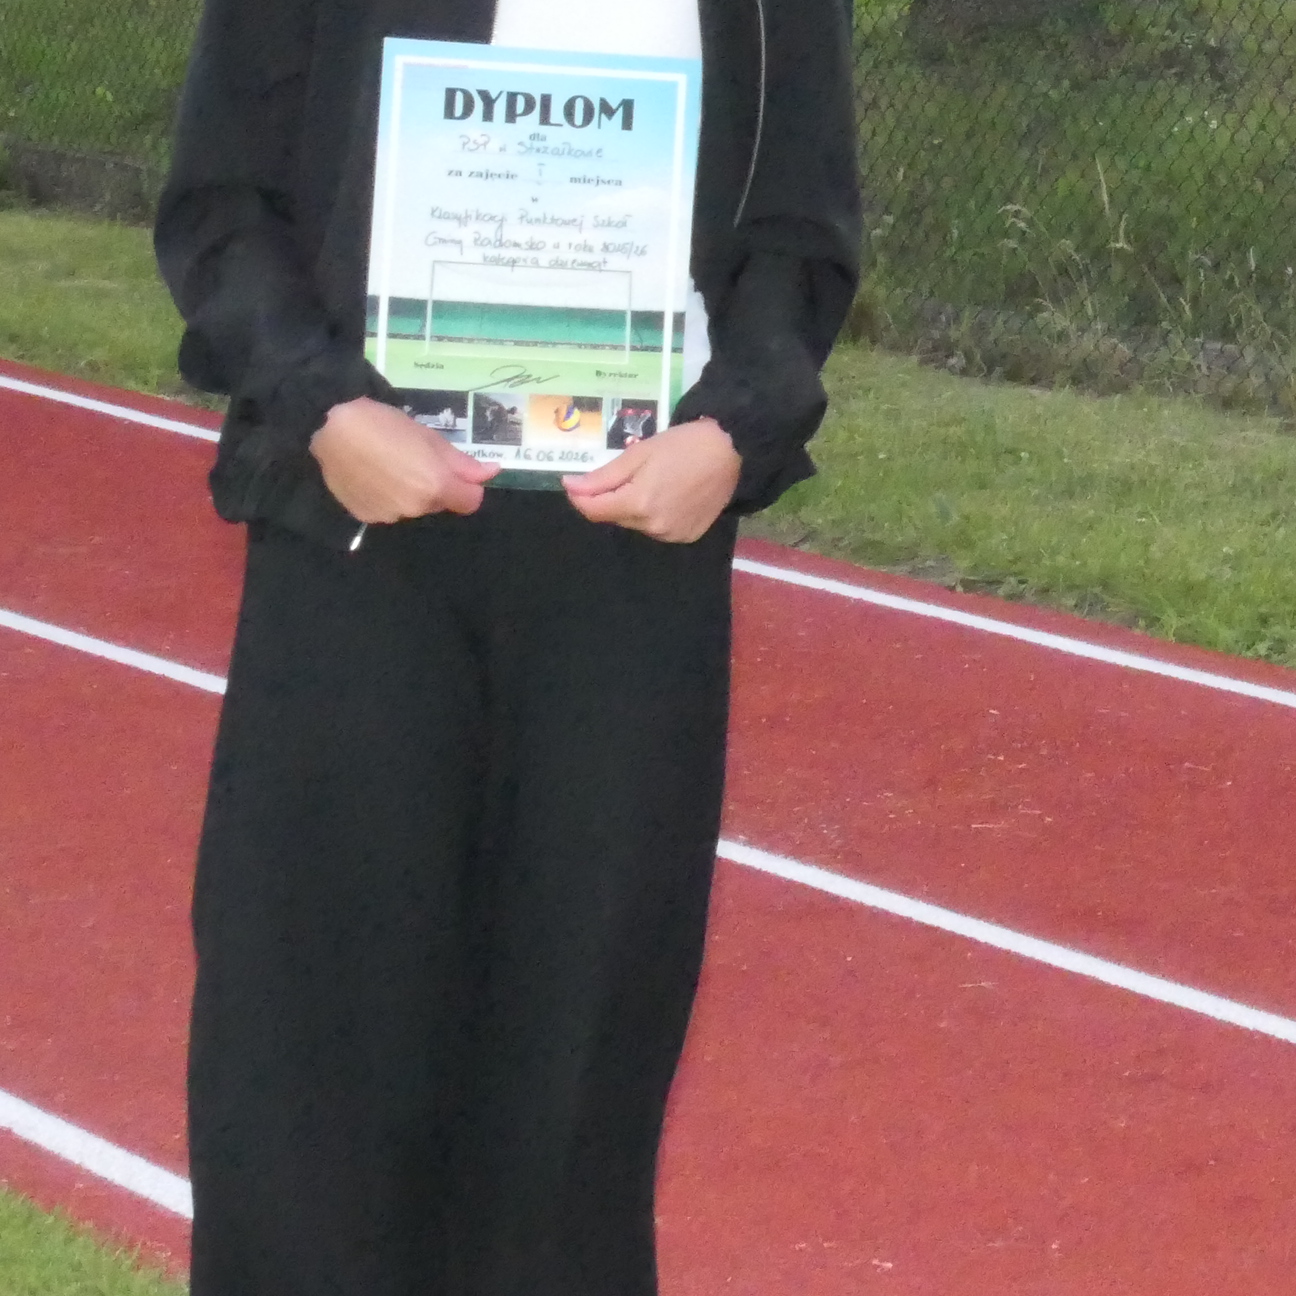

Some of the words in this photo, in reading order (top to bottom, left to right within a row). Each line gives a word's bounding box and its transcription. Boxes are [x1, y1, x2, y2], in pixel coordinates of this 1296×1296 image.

[443, 86, 635, 131] DYPLOM
[528, 132, 547, 142] dla
[447, 169, 463, 177] za
[468, 168, 518, 181] zajęcie
[569, 174, 623, 187] miejsca
